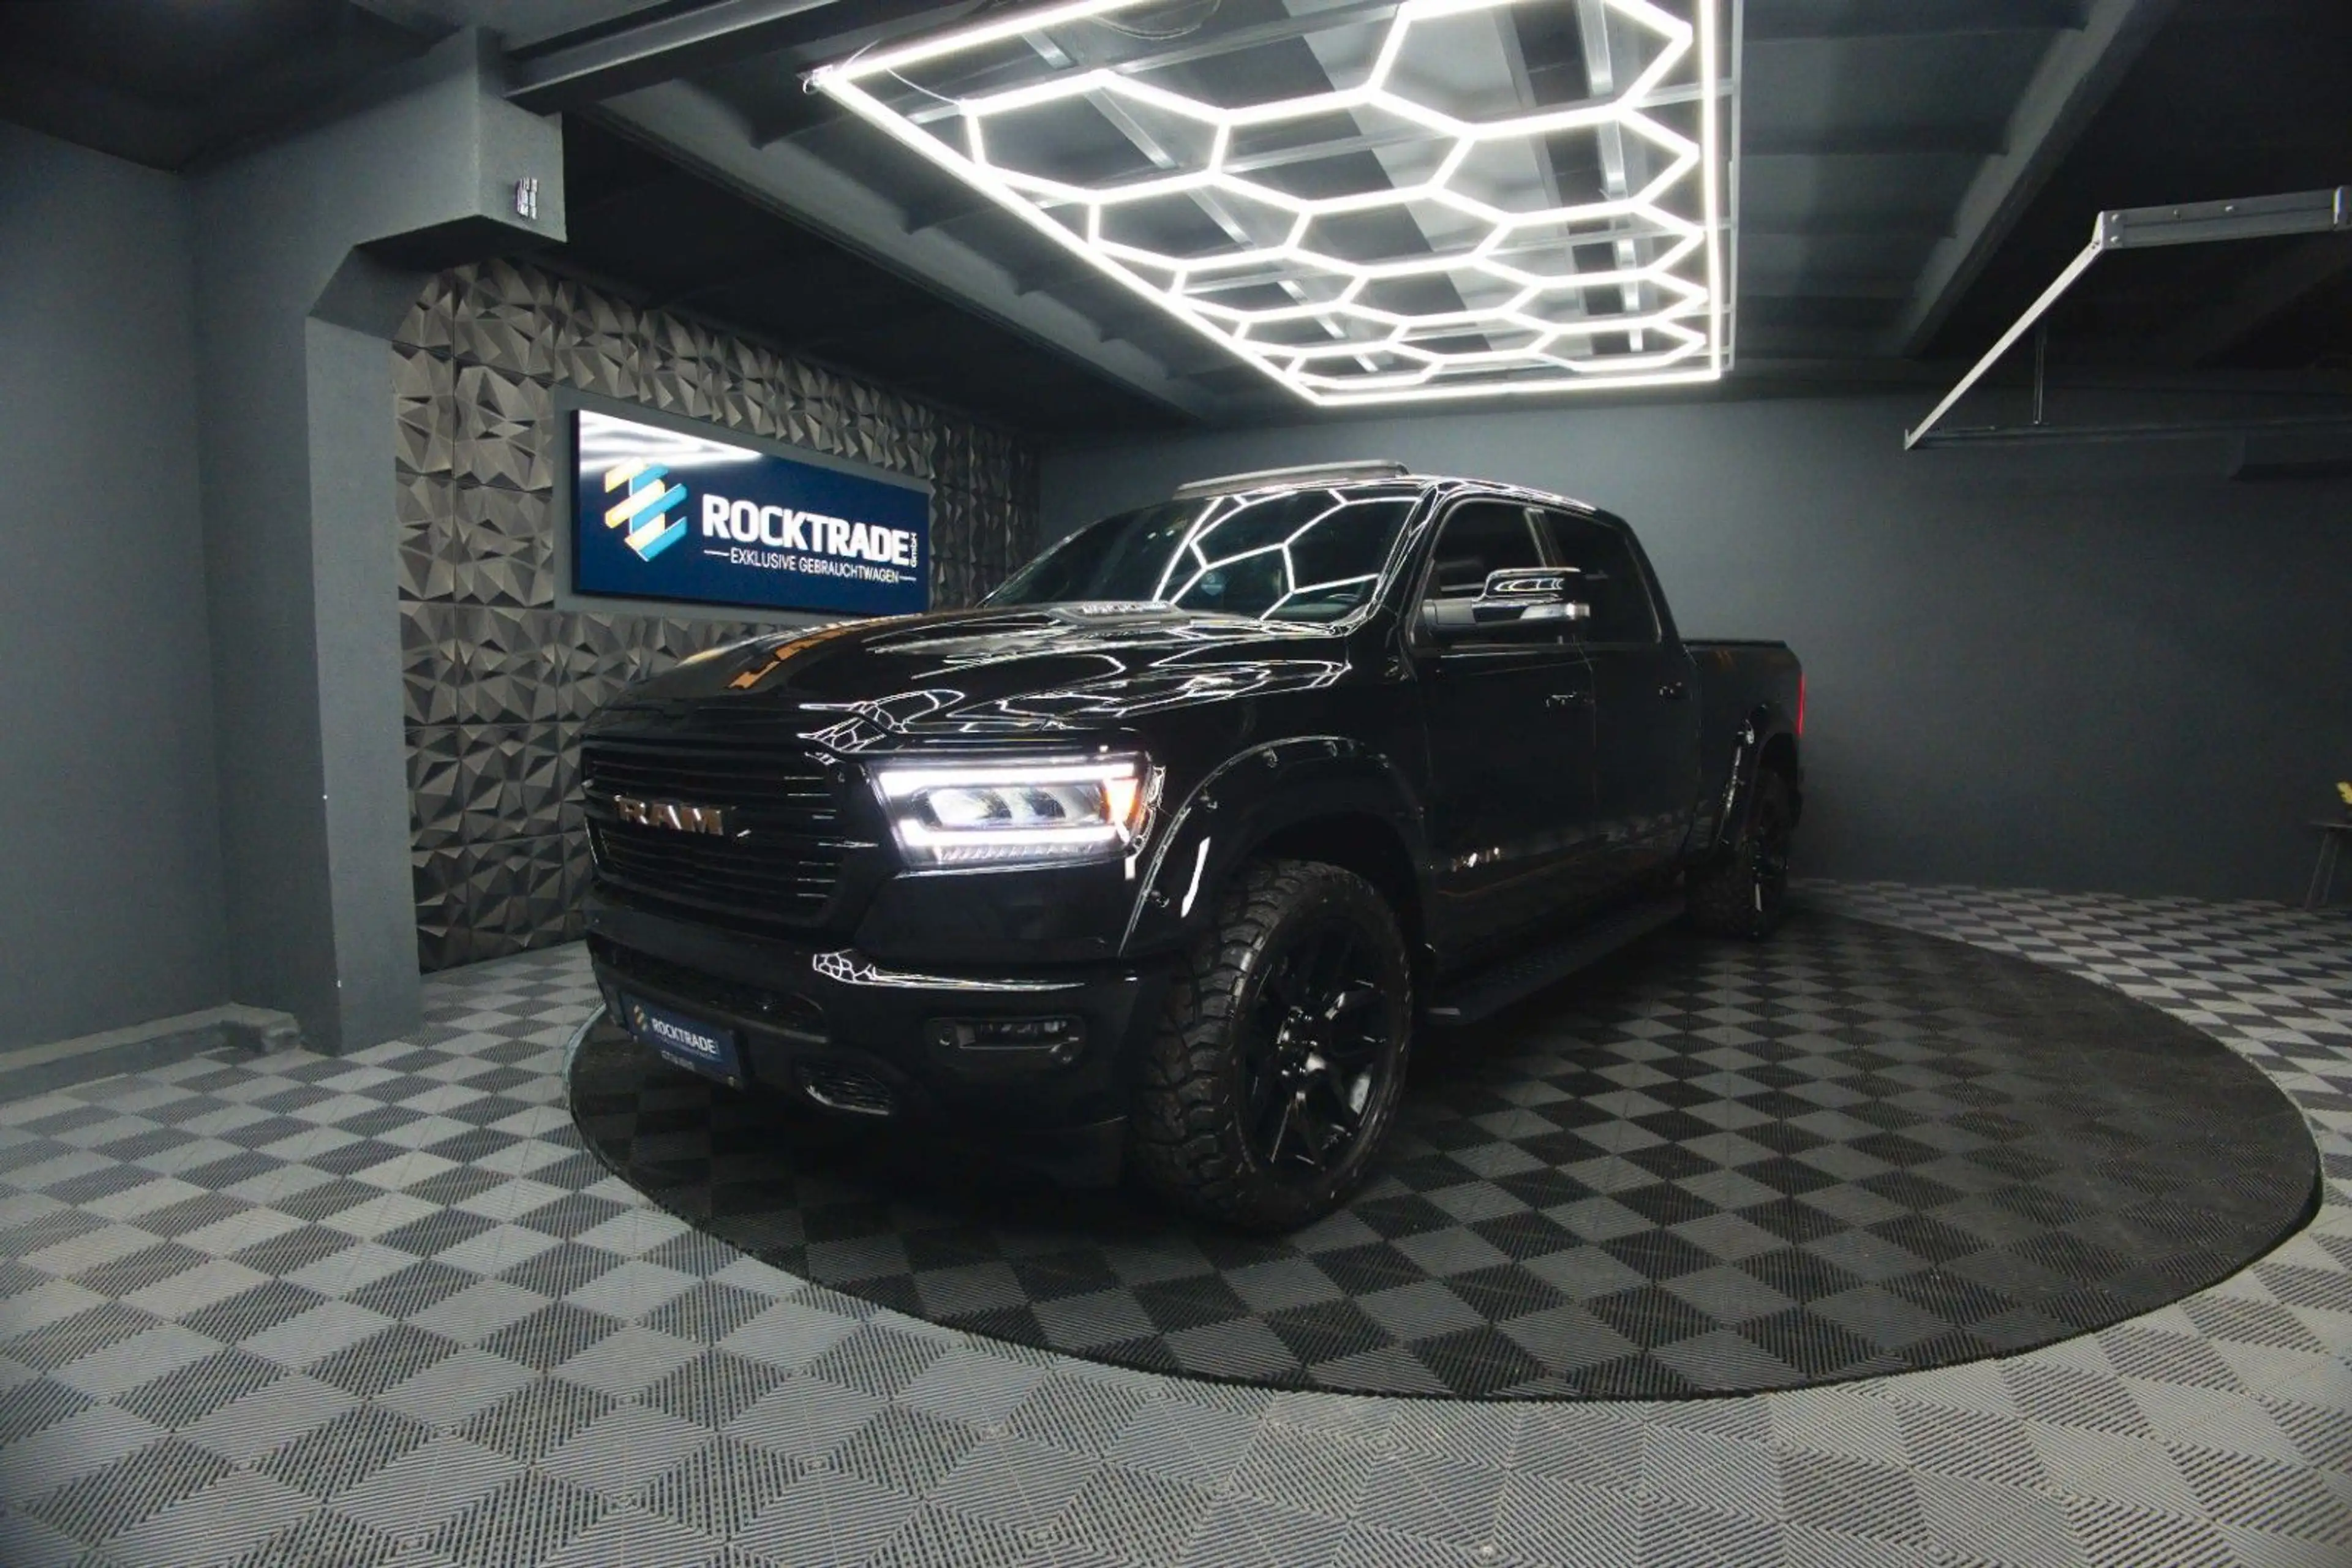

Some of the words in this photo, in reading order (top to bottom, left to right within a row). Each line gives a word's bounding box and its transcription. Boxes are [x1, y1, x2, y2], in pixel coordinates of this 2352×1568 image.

[702, 494, 910, 566] ROCKTRADE
[730, 547, 796, 571] EXKLUSIVE
[798, 557, 899, 584] GEBRAUCHTWAGEN
[614, 795, 724, 836] RAM
[651, 1018, 717, 1055] ROCKTRADE
